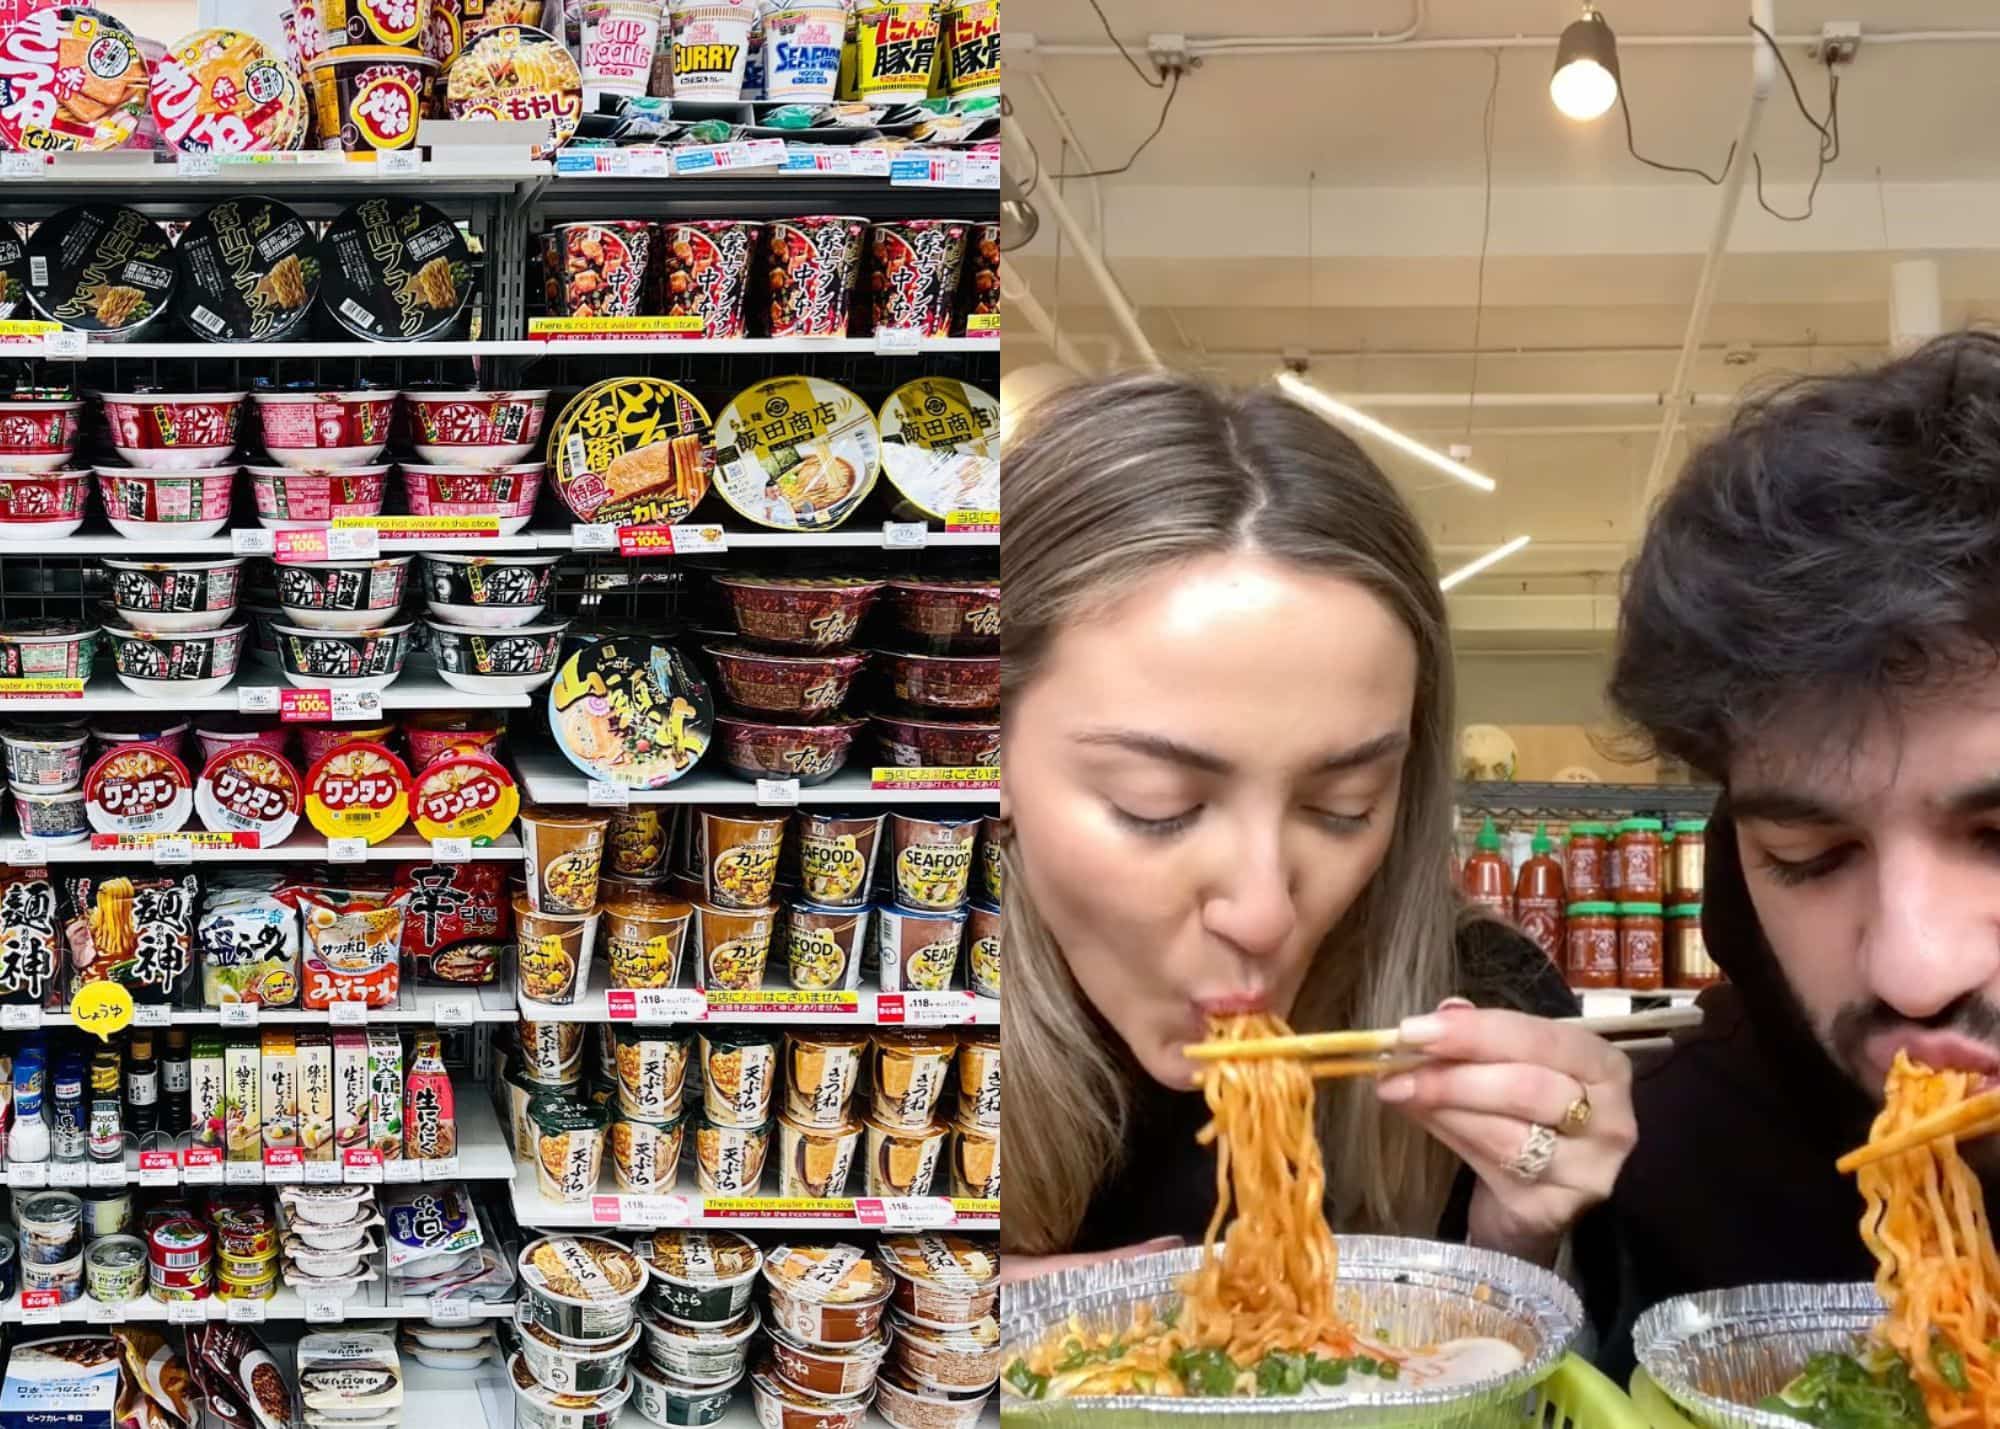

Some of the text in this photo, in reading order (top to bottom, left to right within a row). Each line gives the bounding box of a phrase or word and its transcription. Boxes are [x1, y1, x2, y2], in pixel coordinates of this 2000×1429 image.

[672, 43, 740, 75] CURRY
[507, 95, 574, 120] もやし
[735, 401, 837, 451] 飯田商店
[900, 405, 992, 443] 飯田商店
[104, 779, 172, 809] ワンタン
[217, 775, 284, 815] ワンタン
[326, 779, 394, 804] ワンタン
[430, 781, 497, 819] ワンタン
[905, 849, 970, 867] SEAFOOD
[408, 863, 471, 948] 辛
[78, 1003, 123, 1021] しょうゆ
[416, 1087, 441, 1154] 生にんにく
